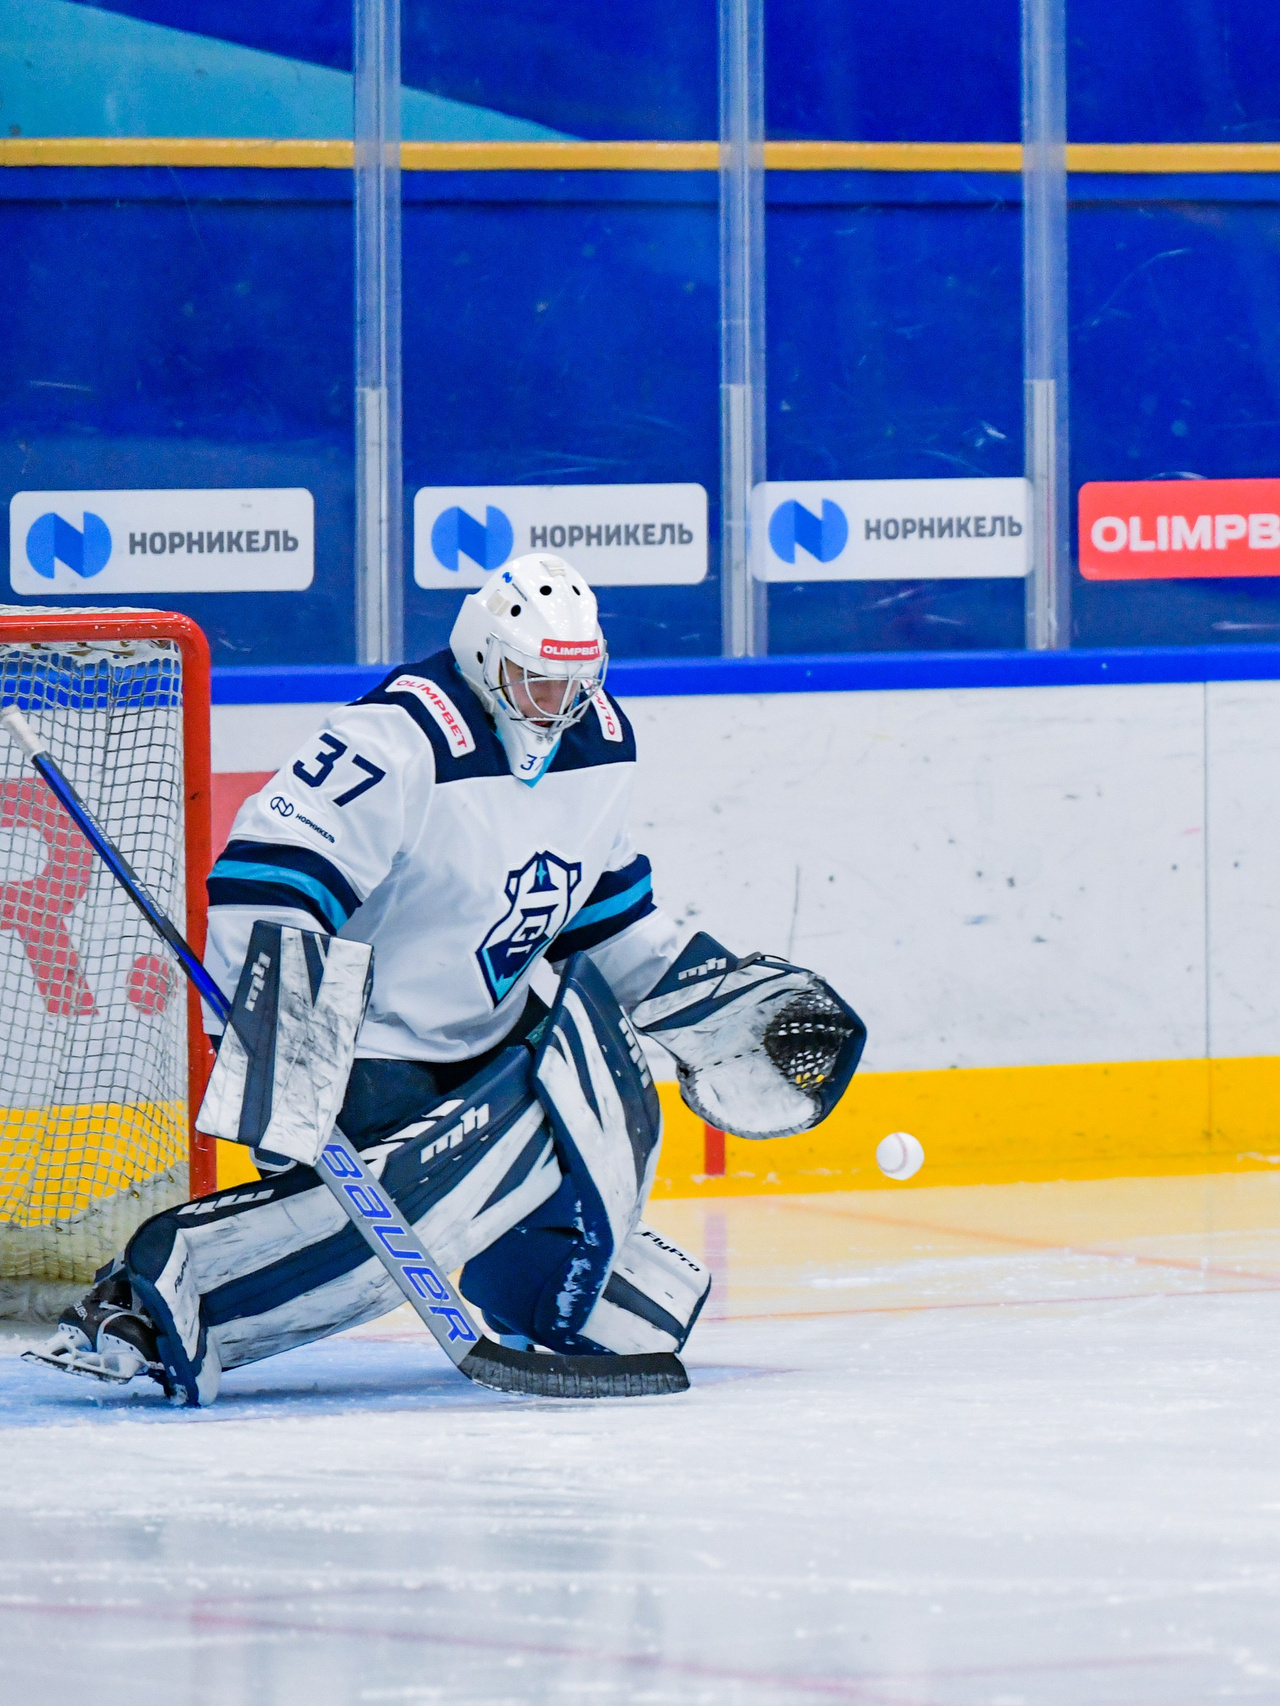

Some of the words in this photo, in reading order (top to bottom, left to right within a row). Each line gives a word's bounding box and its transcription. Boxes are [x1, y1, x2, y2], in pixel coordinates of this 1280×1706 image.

[530, 523, 693, 548] НОРНИКЕЛЬ
[865, 515, 1023, 540] НОРНИКЕЛЬ
[129, 529, 299, 555] НОРНИКЕЛЬ
[543, 645, 599, 656] OLIMPBET
[396, 680, 467, 748] OLIMPBET
[293, 732, 386, 808] 37
[641, 1232, 700, 1272] FlyPro
